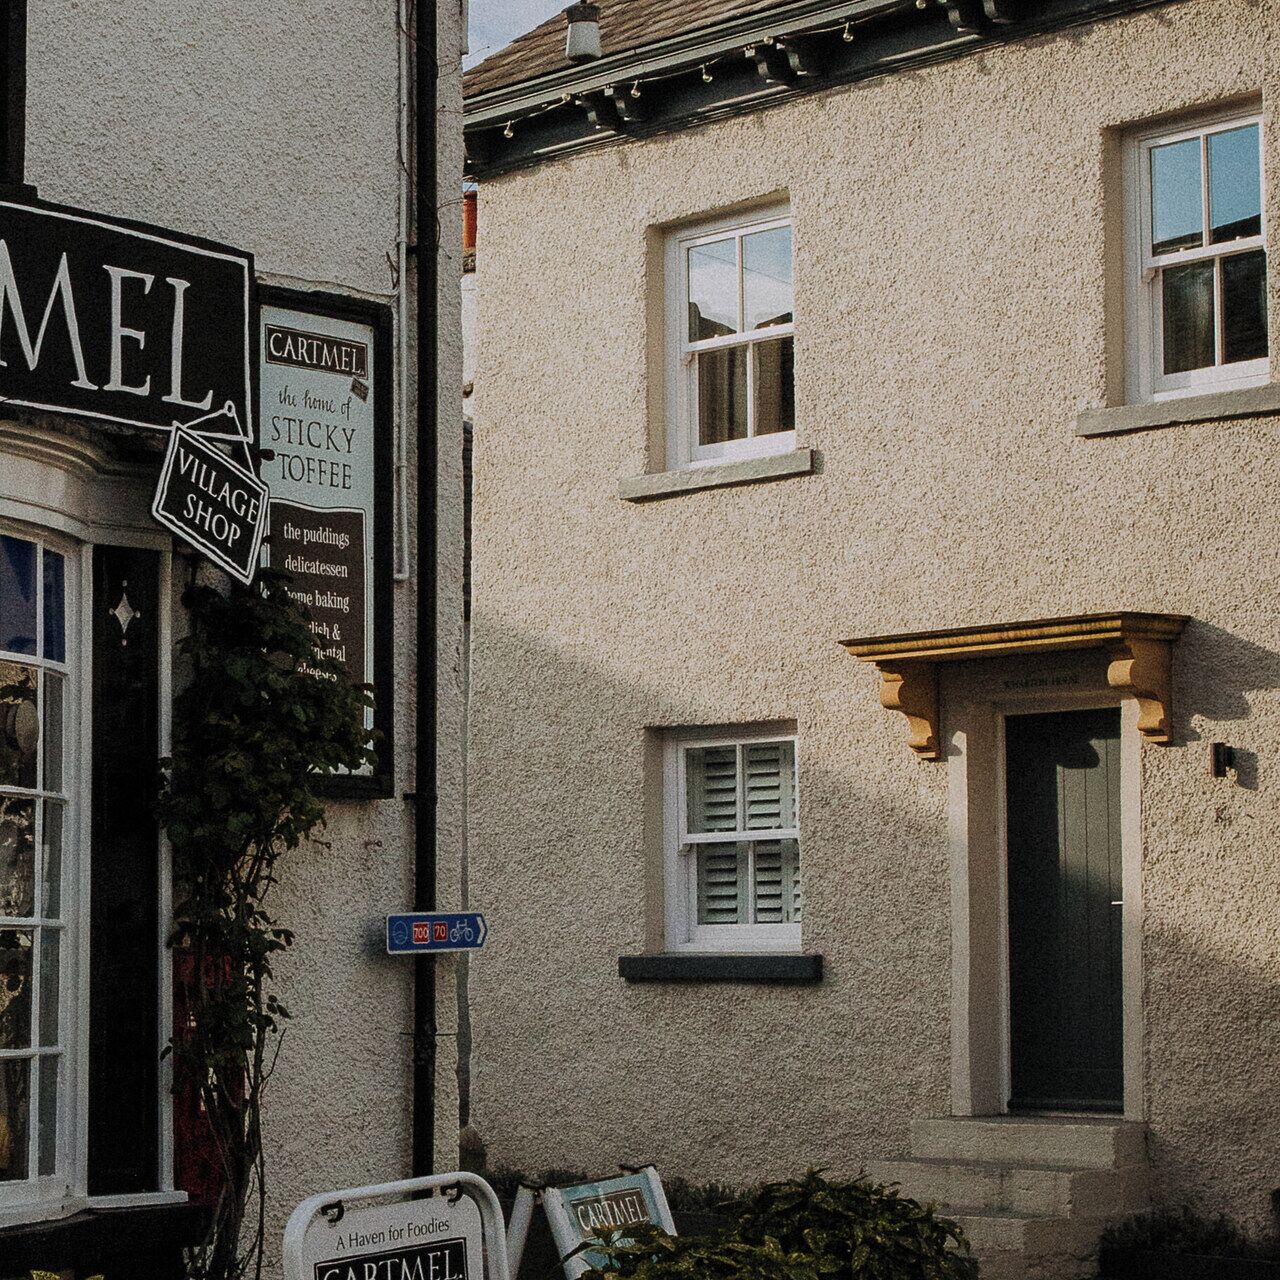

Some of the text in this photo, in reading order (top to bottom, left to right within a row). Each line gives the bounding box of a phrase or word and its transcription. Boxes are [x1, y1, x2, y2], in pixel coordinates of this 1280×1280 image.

[270, 332, 362, 374] CARTMEL
[279, 385, 298, 407] the
[303, 390, 335, 413] home
[341, 396, 352, 420] of
[271, 416, 356, 453] STICKY
[179, 446, 259, 525] VILLAGE
[277, 453, 351, 489] TOFFEE
[183, 493, 241, 548] SHOP
[284, 522, 349, 549] the puddings
[285, 554, 348, 578] delicatessen
[315, 590, 350, 613] baking
[332, 623, 341, 640] &
[435, 925, 446, 938] 70
[577, 1195, 647, 1231] CARTMEL
[336, 1218, 450, 1251] A Haven for Foodies
